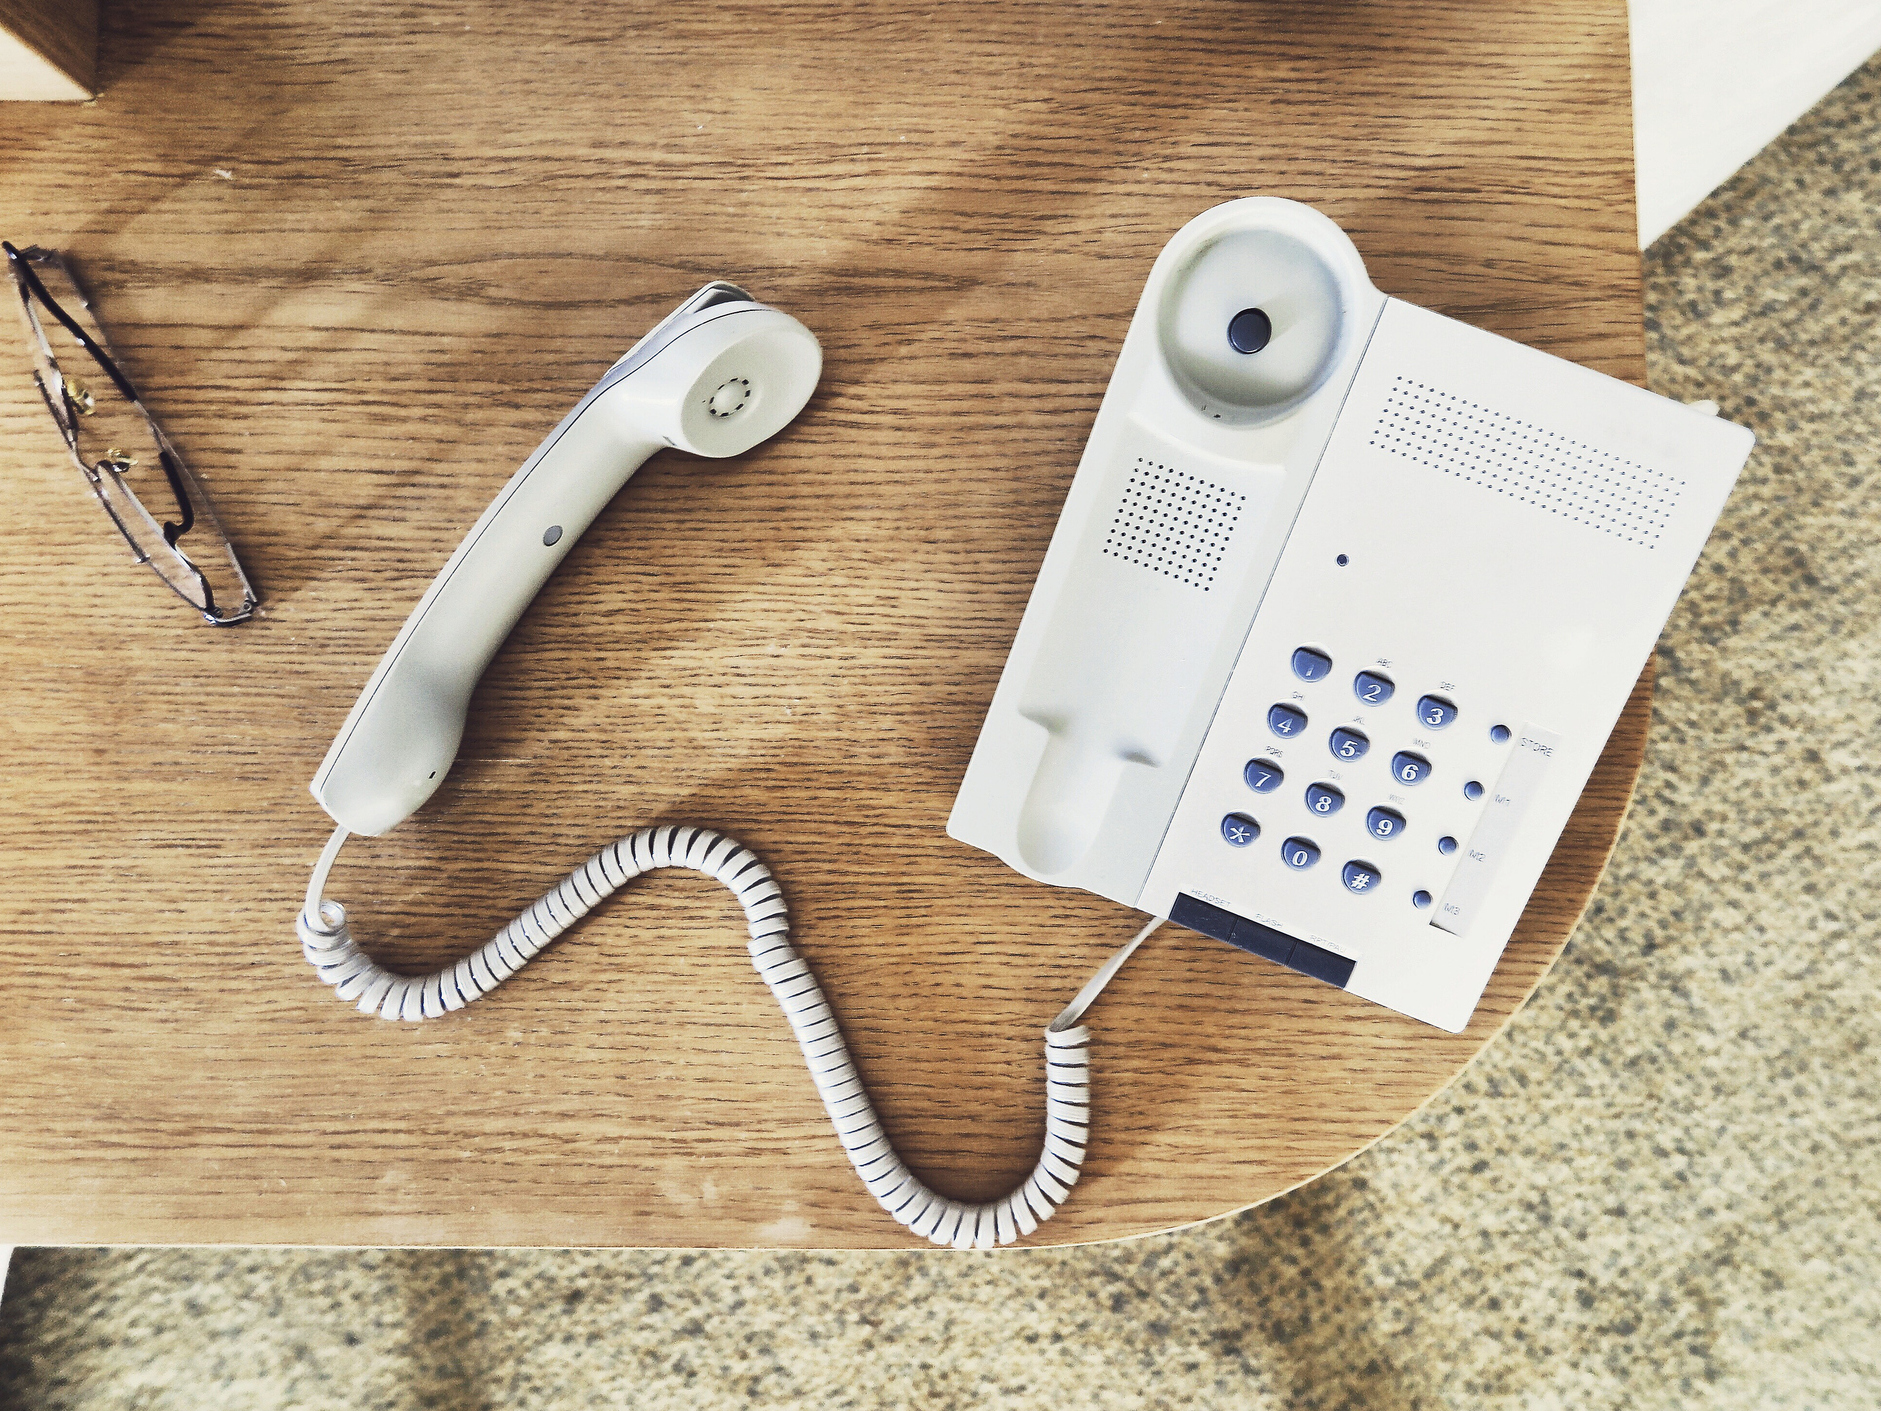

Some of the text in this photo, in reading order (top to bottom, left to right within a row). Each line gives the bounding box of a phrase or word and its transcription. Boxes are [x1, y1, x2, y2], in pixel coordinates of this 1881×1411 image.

[1362, 683, 1383, 702] 2
[1276, 716, 1293, 733] 4
[1426, 706, 1445, 725] 3
[1339, 739, 1358, 757] 5
[1520, 736, 1555, 757] STORE
[1253, 770, 1272, 788] 7
[1401, 763, 1420, 781] 6
[1314, 795, 1333, 812] 8
[1375, 818, 1394, 836] 9
[1291, 850, 1309, 867] 0
[1190, 887, 1232, 908] HEADSET
